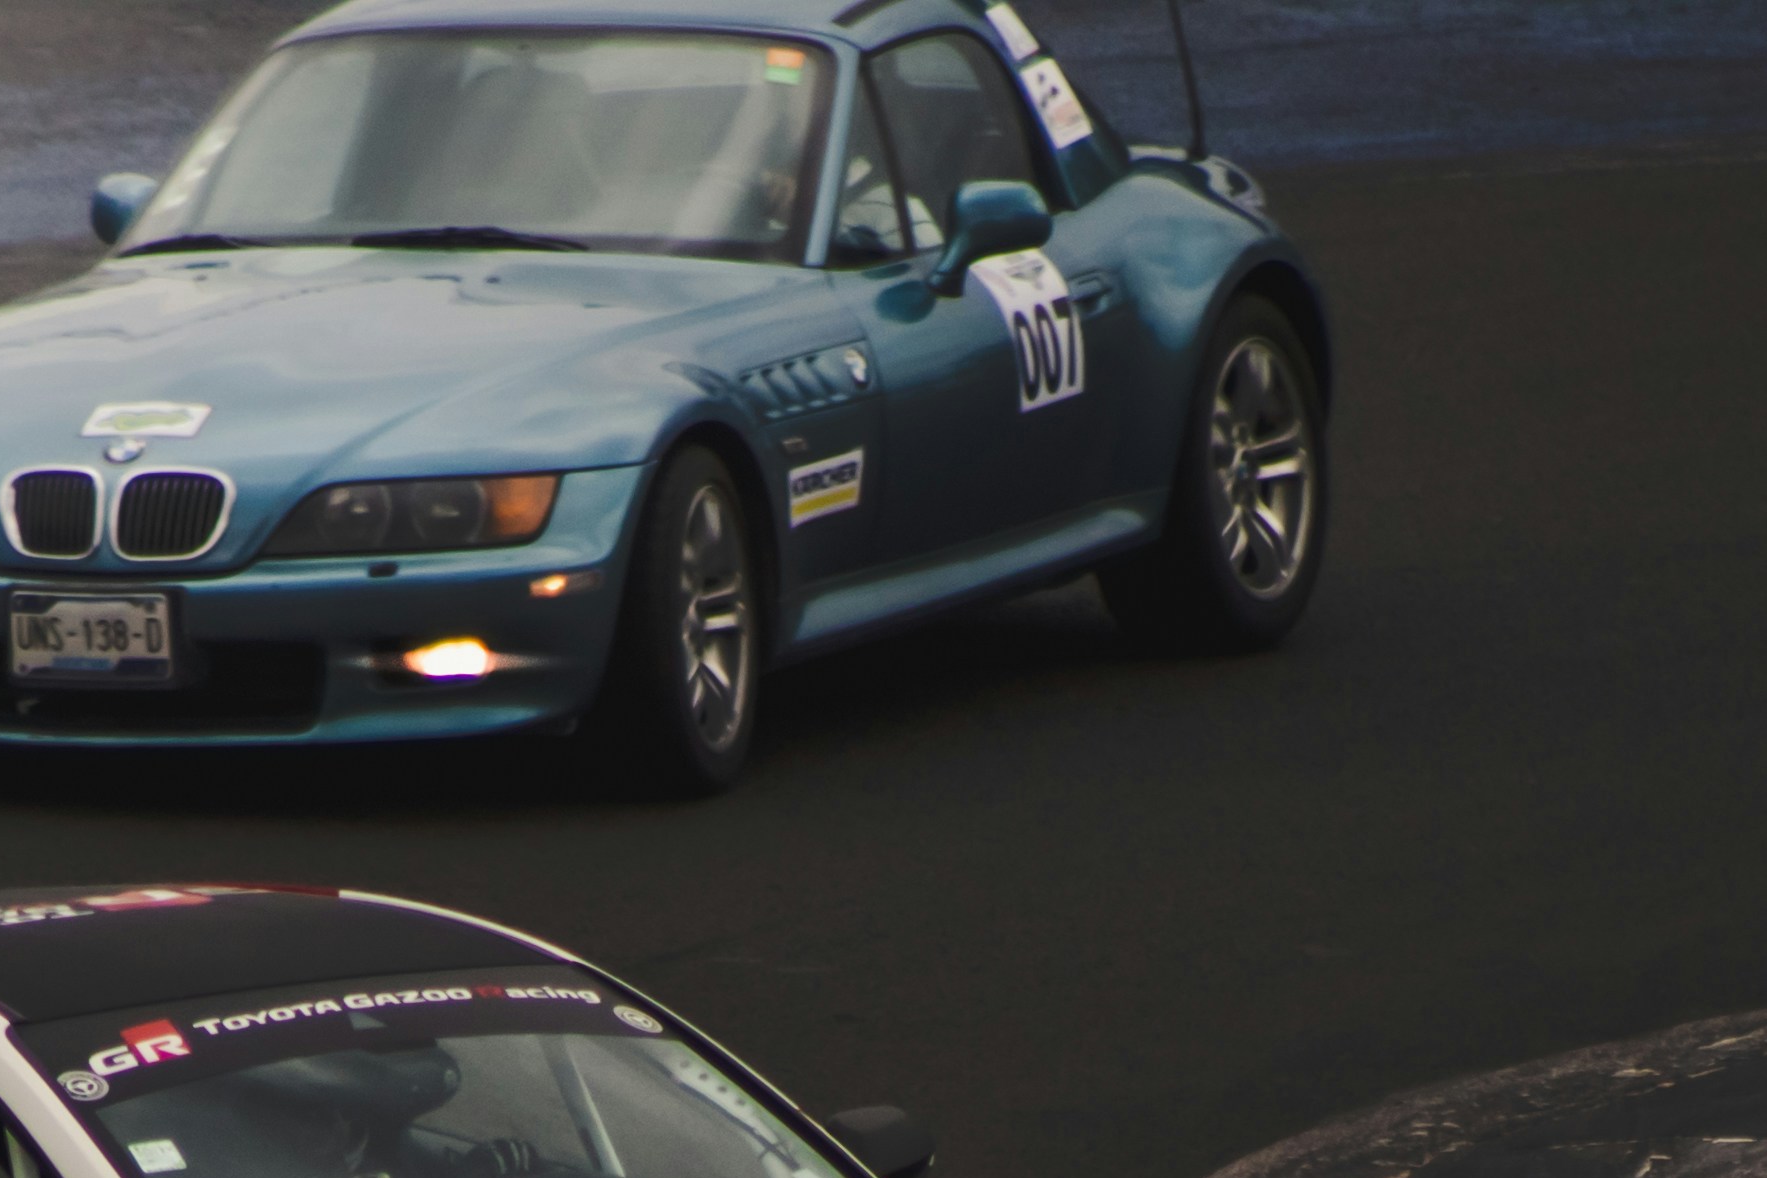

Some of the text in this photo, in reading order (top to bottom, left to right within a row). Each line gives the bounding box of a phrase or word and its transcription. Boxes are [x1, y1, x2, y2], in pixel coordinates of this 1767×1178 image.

[1014, 297, 1076, 401] 007
[16, 616, 163, 653] UNS-138-D
[193, 985, 601, 1036] TOYOTA GAZOO Racing
[88, 1033, 192, 1076] GR
